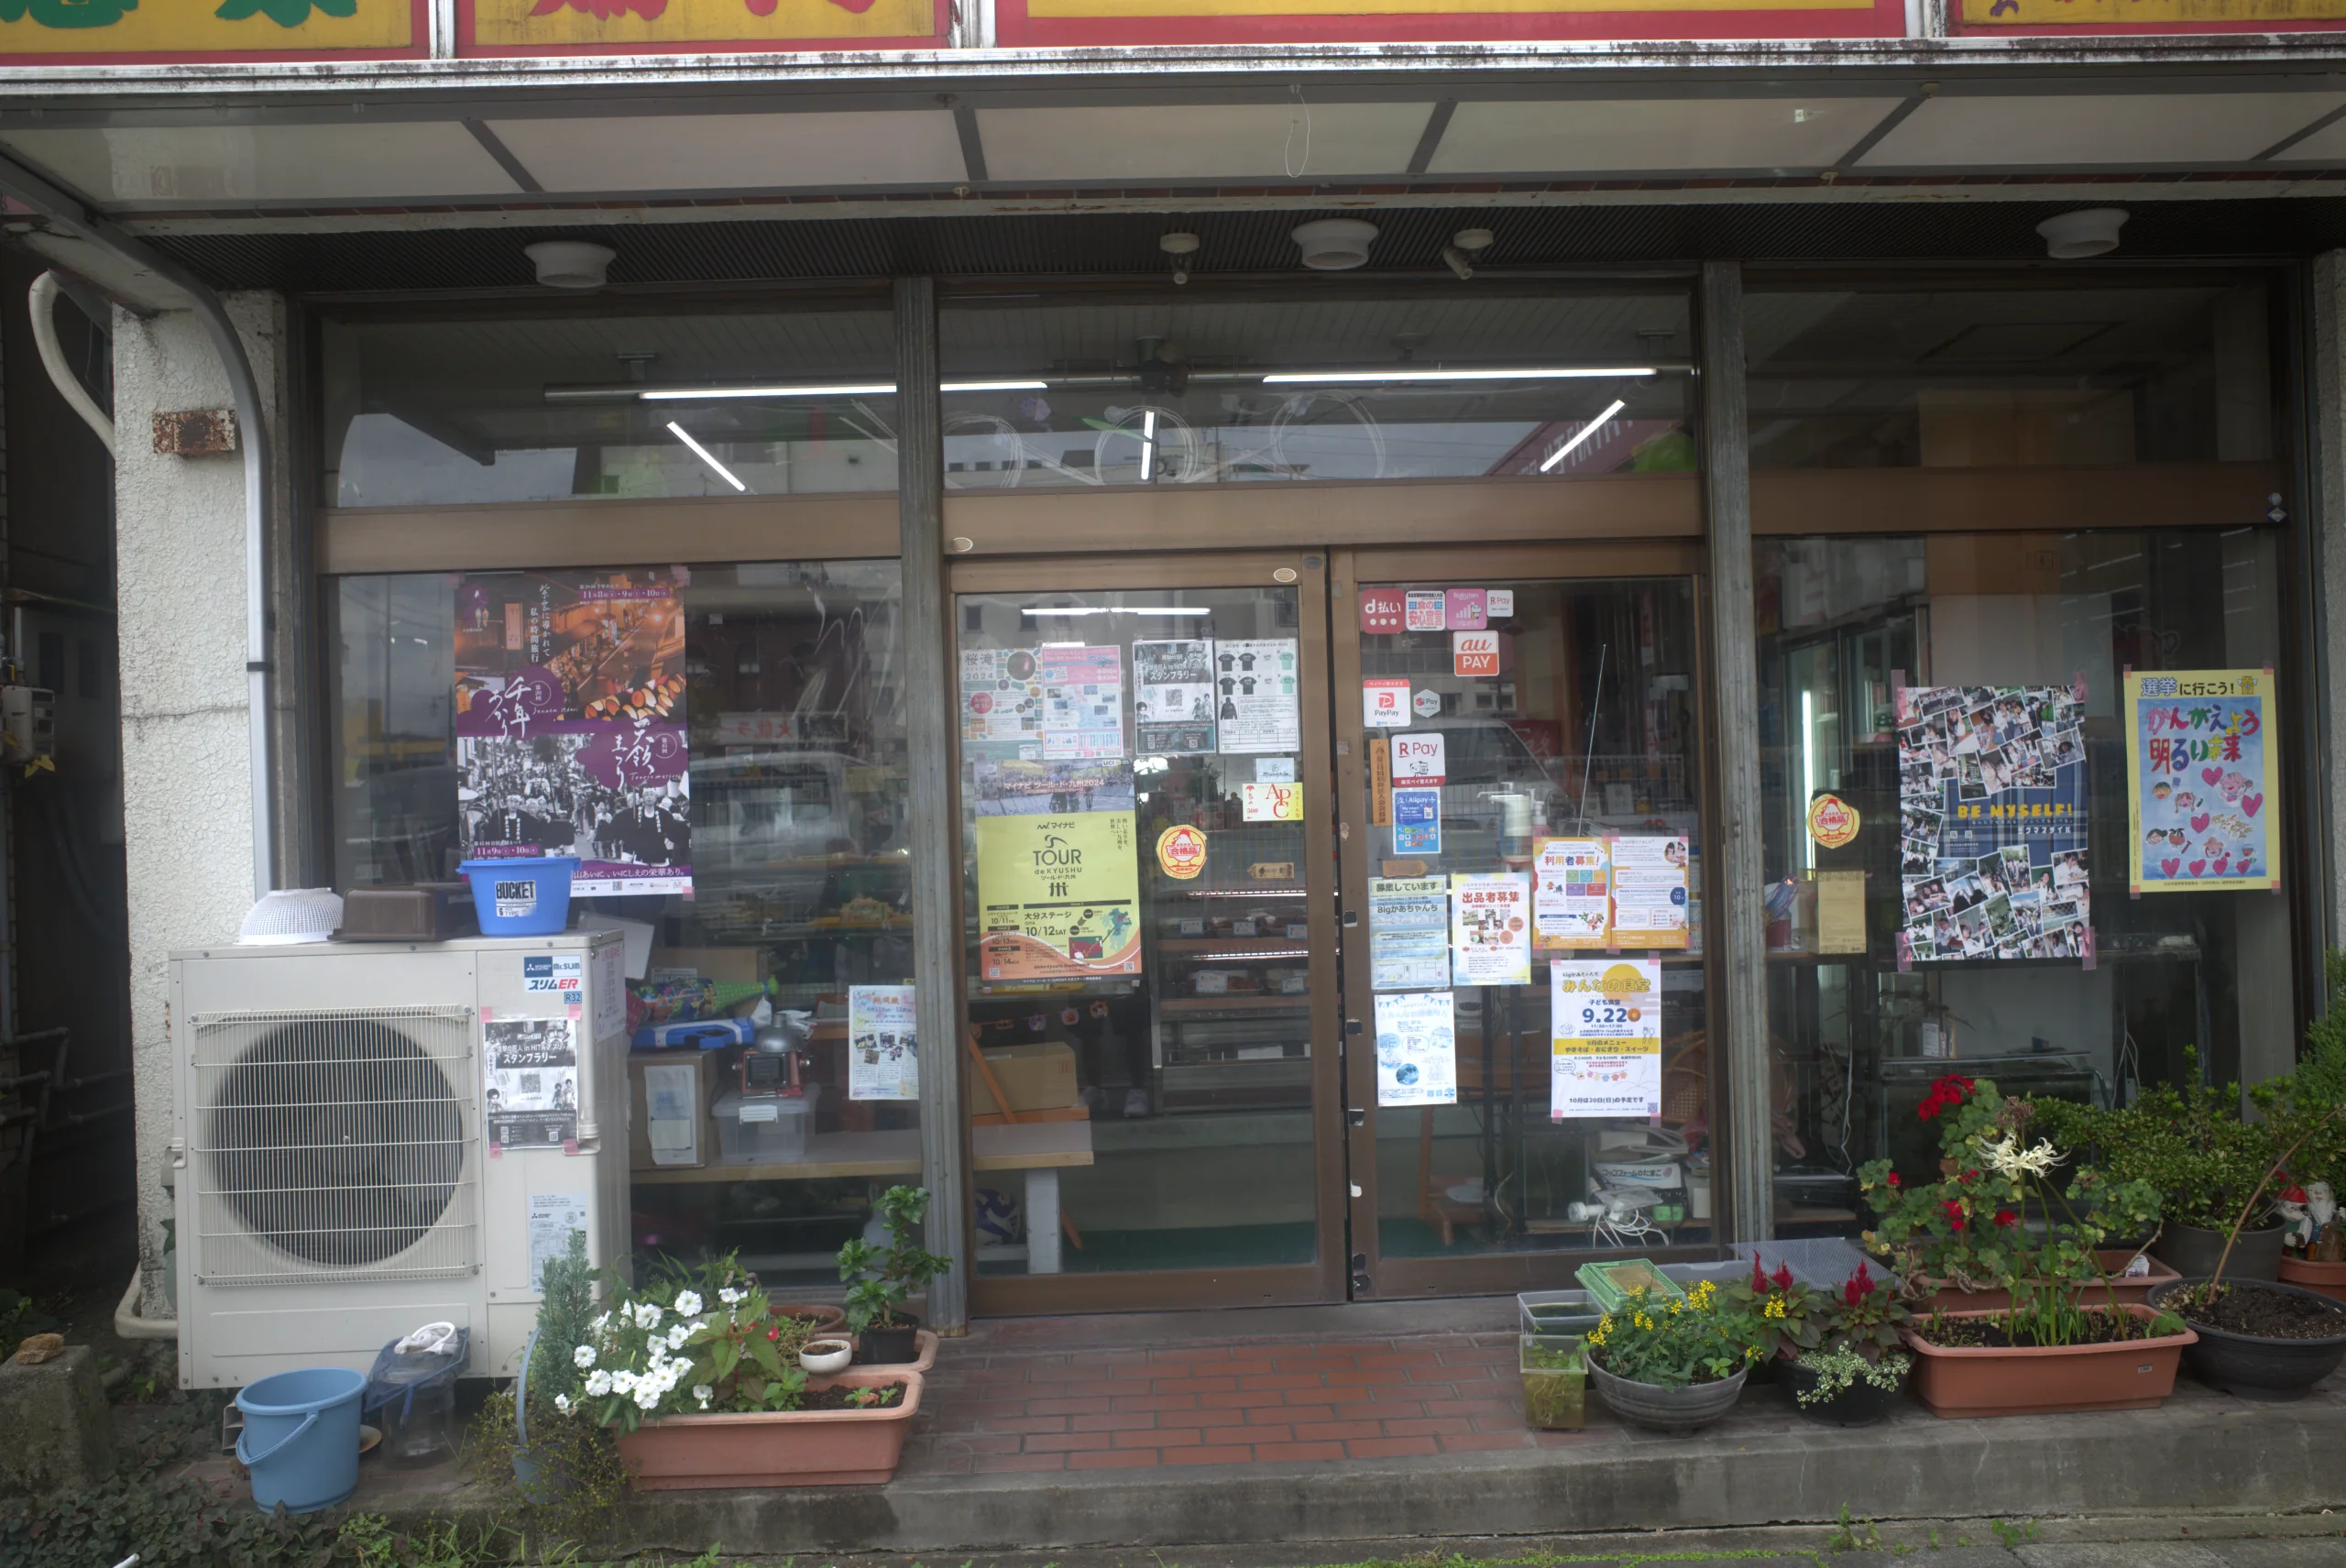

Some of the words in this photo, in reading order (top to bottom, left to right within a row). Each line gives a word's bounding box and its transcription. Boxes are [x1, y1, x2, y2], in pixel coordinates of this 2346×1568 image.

[1365, 599, 1401, 614] d払い
[1496, 597, 1510, 606] Pay
[530, 607, 540, 663] 私の時間旅行
[1460, 639, 1492, 652] au
[1463, 655, 1491, 669] PAY
[1150, 670, 1197, 681] スタンプラリー
[2146, 704, 2260, 736] かんがえよう
[1412, 742, 1438, 757] Pay
[2149, 733, 2242, 774] 明るい未来
[1957, 805, 1981, 819] BE
[1990, 804, 2073, 818] MYSELF!
[1050, 821, 1076, 829] マイナビ
[1819, 816, 1848, 825] 合格品
[1171, 847, 1197, 855] 合格品
[1033, 849, 1082, 866] TOUR
[496, 881, 535, 899] BUCKET
[1376, 882, 1438, 893] 募集しています
[1463, 891, 1519, 903] 出品者募集
[1025, 911, 1072, 920] 大分ステージ
[1377, 904, 1438, 915] Bigかあちゃんち
[1025, 926, 1055, 937] 10/12
[1562, 978, 1651, 992] みんなの食堂
[565, 993, 581, 1002] R32
[1583, 1008, 1628, 1023] 9.22
[504, 1052, 557, 1064] スタンプラリー
